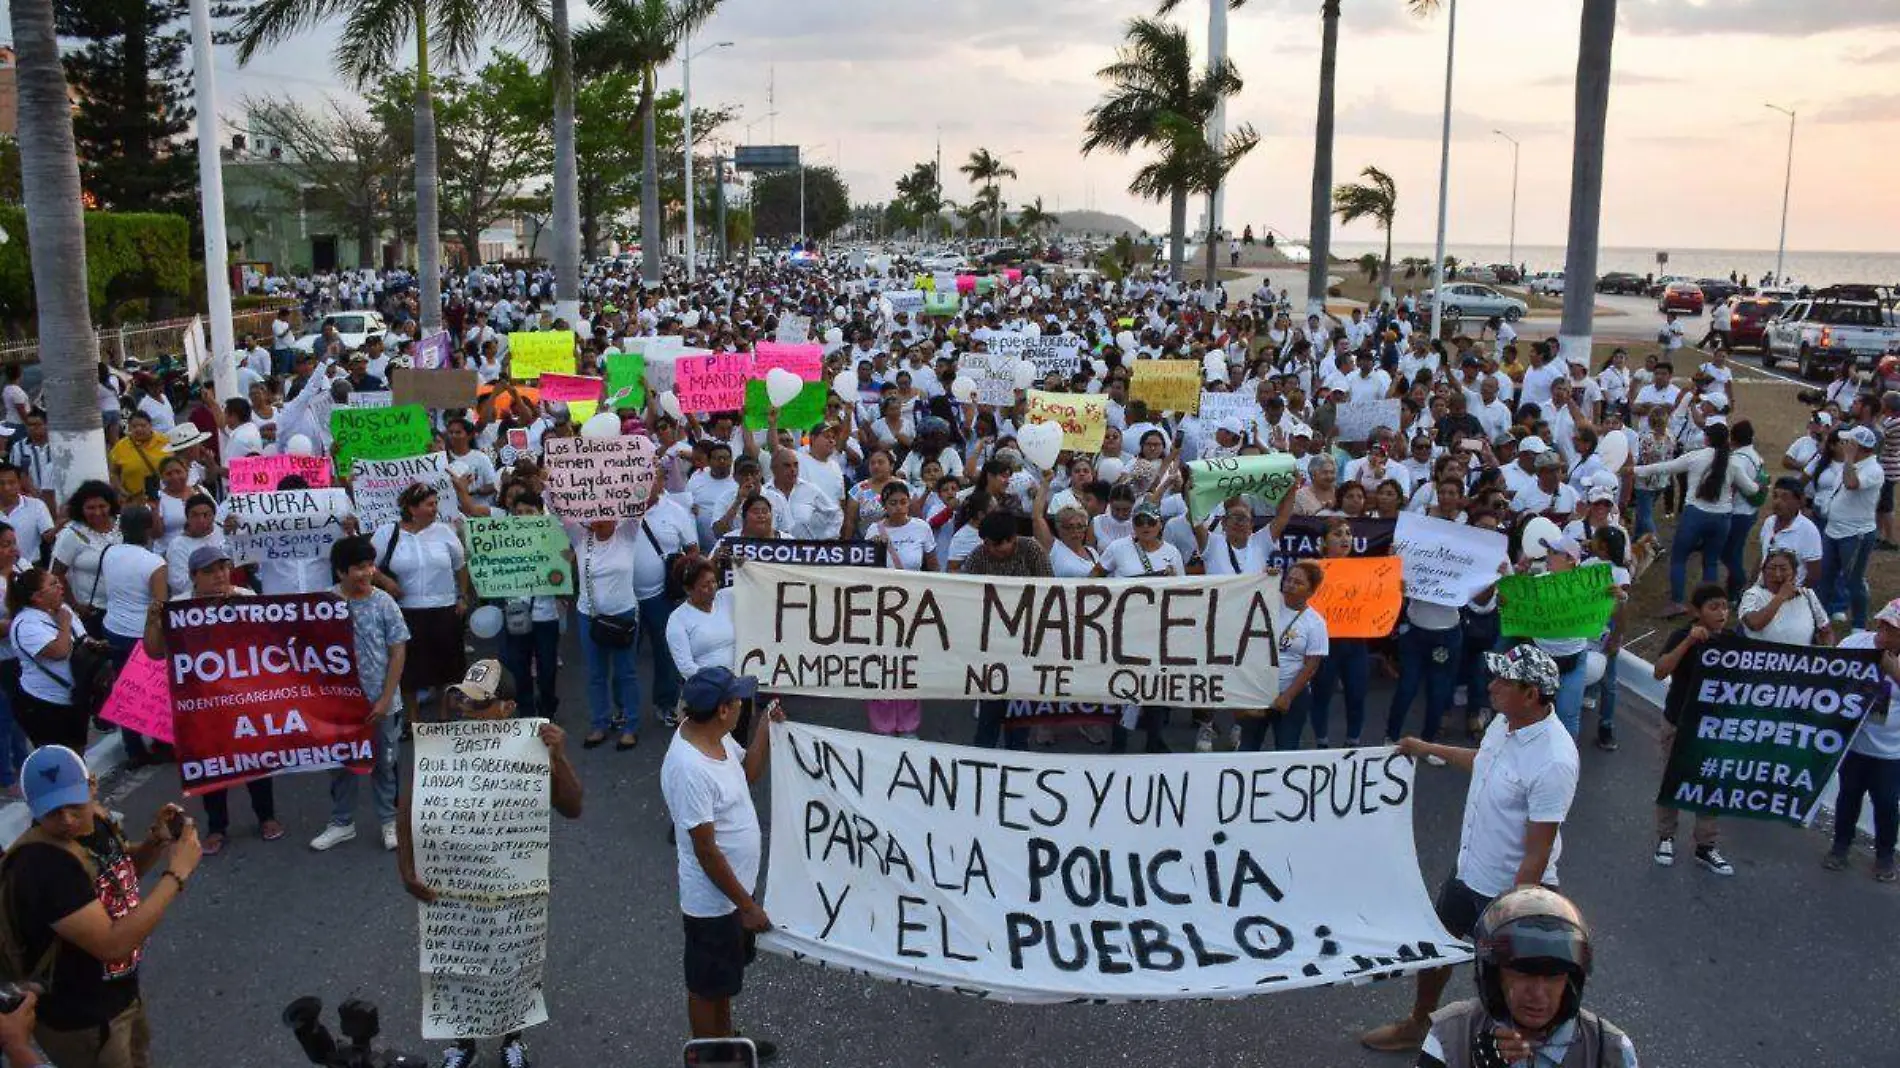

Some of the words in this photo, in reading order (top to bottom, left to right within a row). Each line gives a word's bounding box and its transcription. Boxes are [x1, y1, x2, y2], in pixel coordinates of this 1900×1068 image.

[689, 371, 747, 391] MANDA
[547, 441, 569, 455] Los
[575, 437, 622, 453] Policias
[373, 461, 399, 477] NO
[400, 455, 440, 475] HAY
[1205, 458, 1239, 471] NO
[228, 491, 319, 515] #FUERA
[605, 487, 631, 499] NOS
[239, 514, 342, 534] MARCELA
[468, 519, 509, 534] Todos
[251, 536, 275, 549] NO
[279, 533, 334, 546] SOMOS
[472, 534, 533, 554] Policias
[732, 543, 845, 564] ESCOLTAS
[850, 547, 875, 563] DE
[169, 602, 298, 629] NOSOTROS
[303, 601, 349, 621] LOS
[775, 581, 950, 651] FUERA
[980, 582, 1280, 668] MARCELA
[173, 636, 351, 684] POLICÍAS
[1700, 648, 1879, 683] GOBERNADORA
[740, 647, 919, 690] CAMPECHE
[964, 661, 1010, 696] NO
[1033, 664, 1074, 697] TE
[177, 699, 194, 711] NO
[195, 686, 299, 709] ENTREGAREMOS
[301, 686, 315, 696] EL
[319, 686, 362, 697] ESTADO
[1697, 679, 1864, 719] EXIGIMOS
[234, 715, 259, 739] A
[264, 709, 309, 736] LA
[417, 721, 522, 737] CAMPECHANOS
[530, 721, 540, 737] Y
[1697, 715, 1844, 754] RESPETO
[451, 736, 501, 753] BASTA
[182, 739, 373, 780] DELINCUENCIA
[419, 757, 449, 773] QUE
[451, 758, 469, 772] LA
[421, 774, 464, 789] LAYDA
[468, 774, 543, 792] SANSORES
[788, 732, 864, 798] UN
[888, 751, 1069, 832] ANTES
[1084, 769, 1116, 829] Y
[1125, 771, 1190, 828] UN
[1217, 750, 1413, 825] DESPÚES
[1700, 757, 1814, 792] #FUERA
[422, 796, 449, 807] NOS
[453, 797, 486, 809] ESTE
[491, 797, 538, 809] VIENDO
[420, 811, 436, 820] LA
[441, 810, 476, 822] CARA
[481, 811, 489, 822] Y
[493, 811, 524, 822] ELLA
[804, 800, 916, 883] PARA
[926, 832, 997, 899] LA
[426, 924, 481, 936] MARCHA
[488, 924, 522, 937] PARA
[816, 882, 851, 940] Y
[896, 894, 979, 962] EL
[424, 939, 447, 950] QUE
[451, 939, 491, 953] LAYDA
